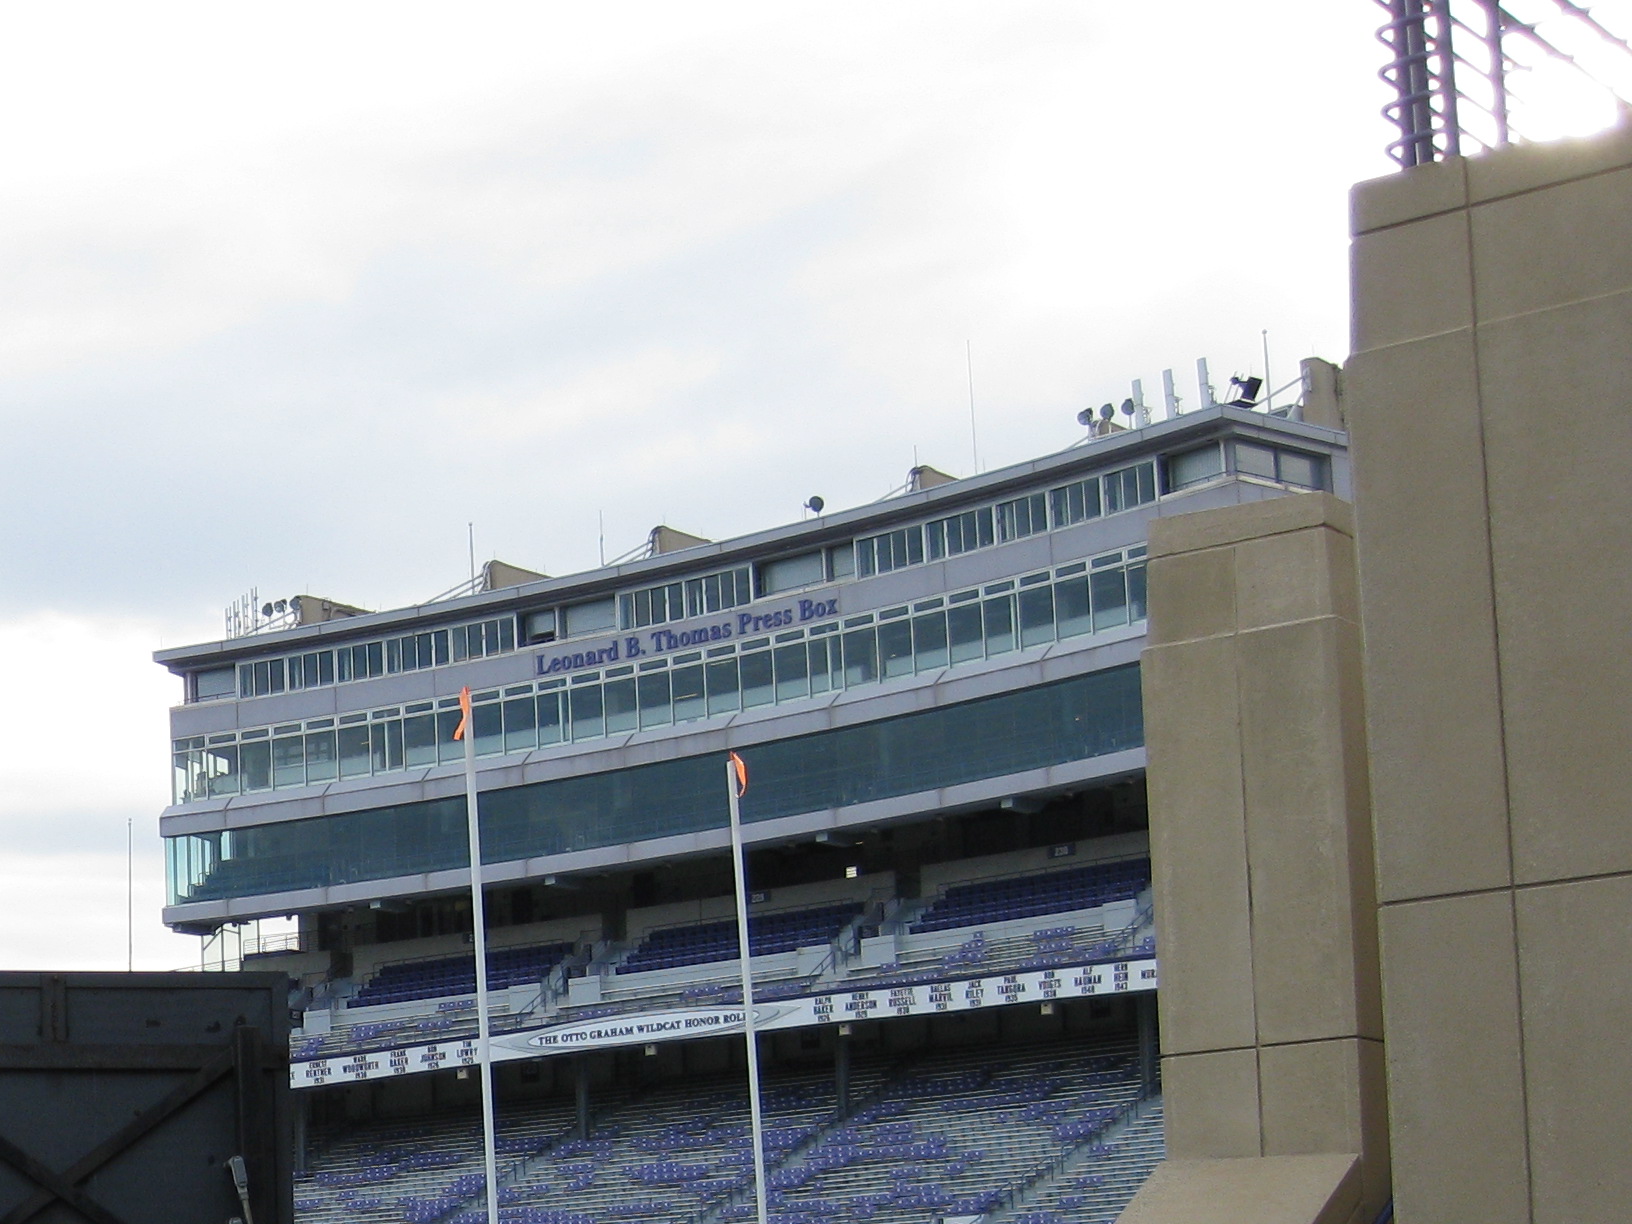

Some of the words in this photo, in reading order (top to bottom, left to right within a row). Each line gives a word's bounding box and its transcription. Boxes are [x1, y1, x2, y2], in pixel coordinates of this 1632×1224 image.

[536, 640, 619, 675] Leonard
[625, 637, 646, 658] B.
[651, 623, 732, 652] Thomas
[737, 608, 792, 635] Press
[798, 598, 838, 621] Box
[538, 1035, 558, 1046] THE
[561, 1031, 588, 1043] OTTO
[589, 1026, 634, 1040] GRAHAM
[637, 1020, 681, 1034] WILDCAT
[684, 1015, 720, 1028] HONOR
